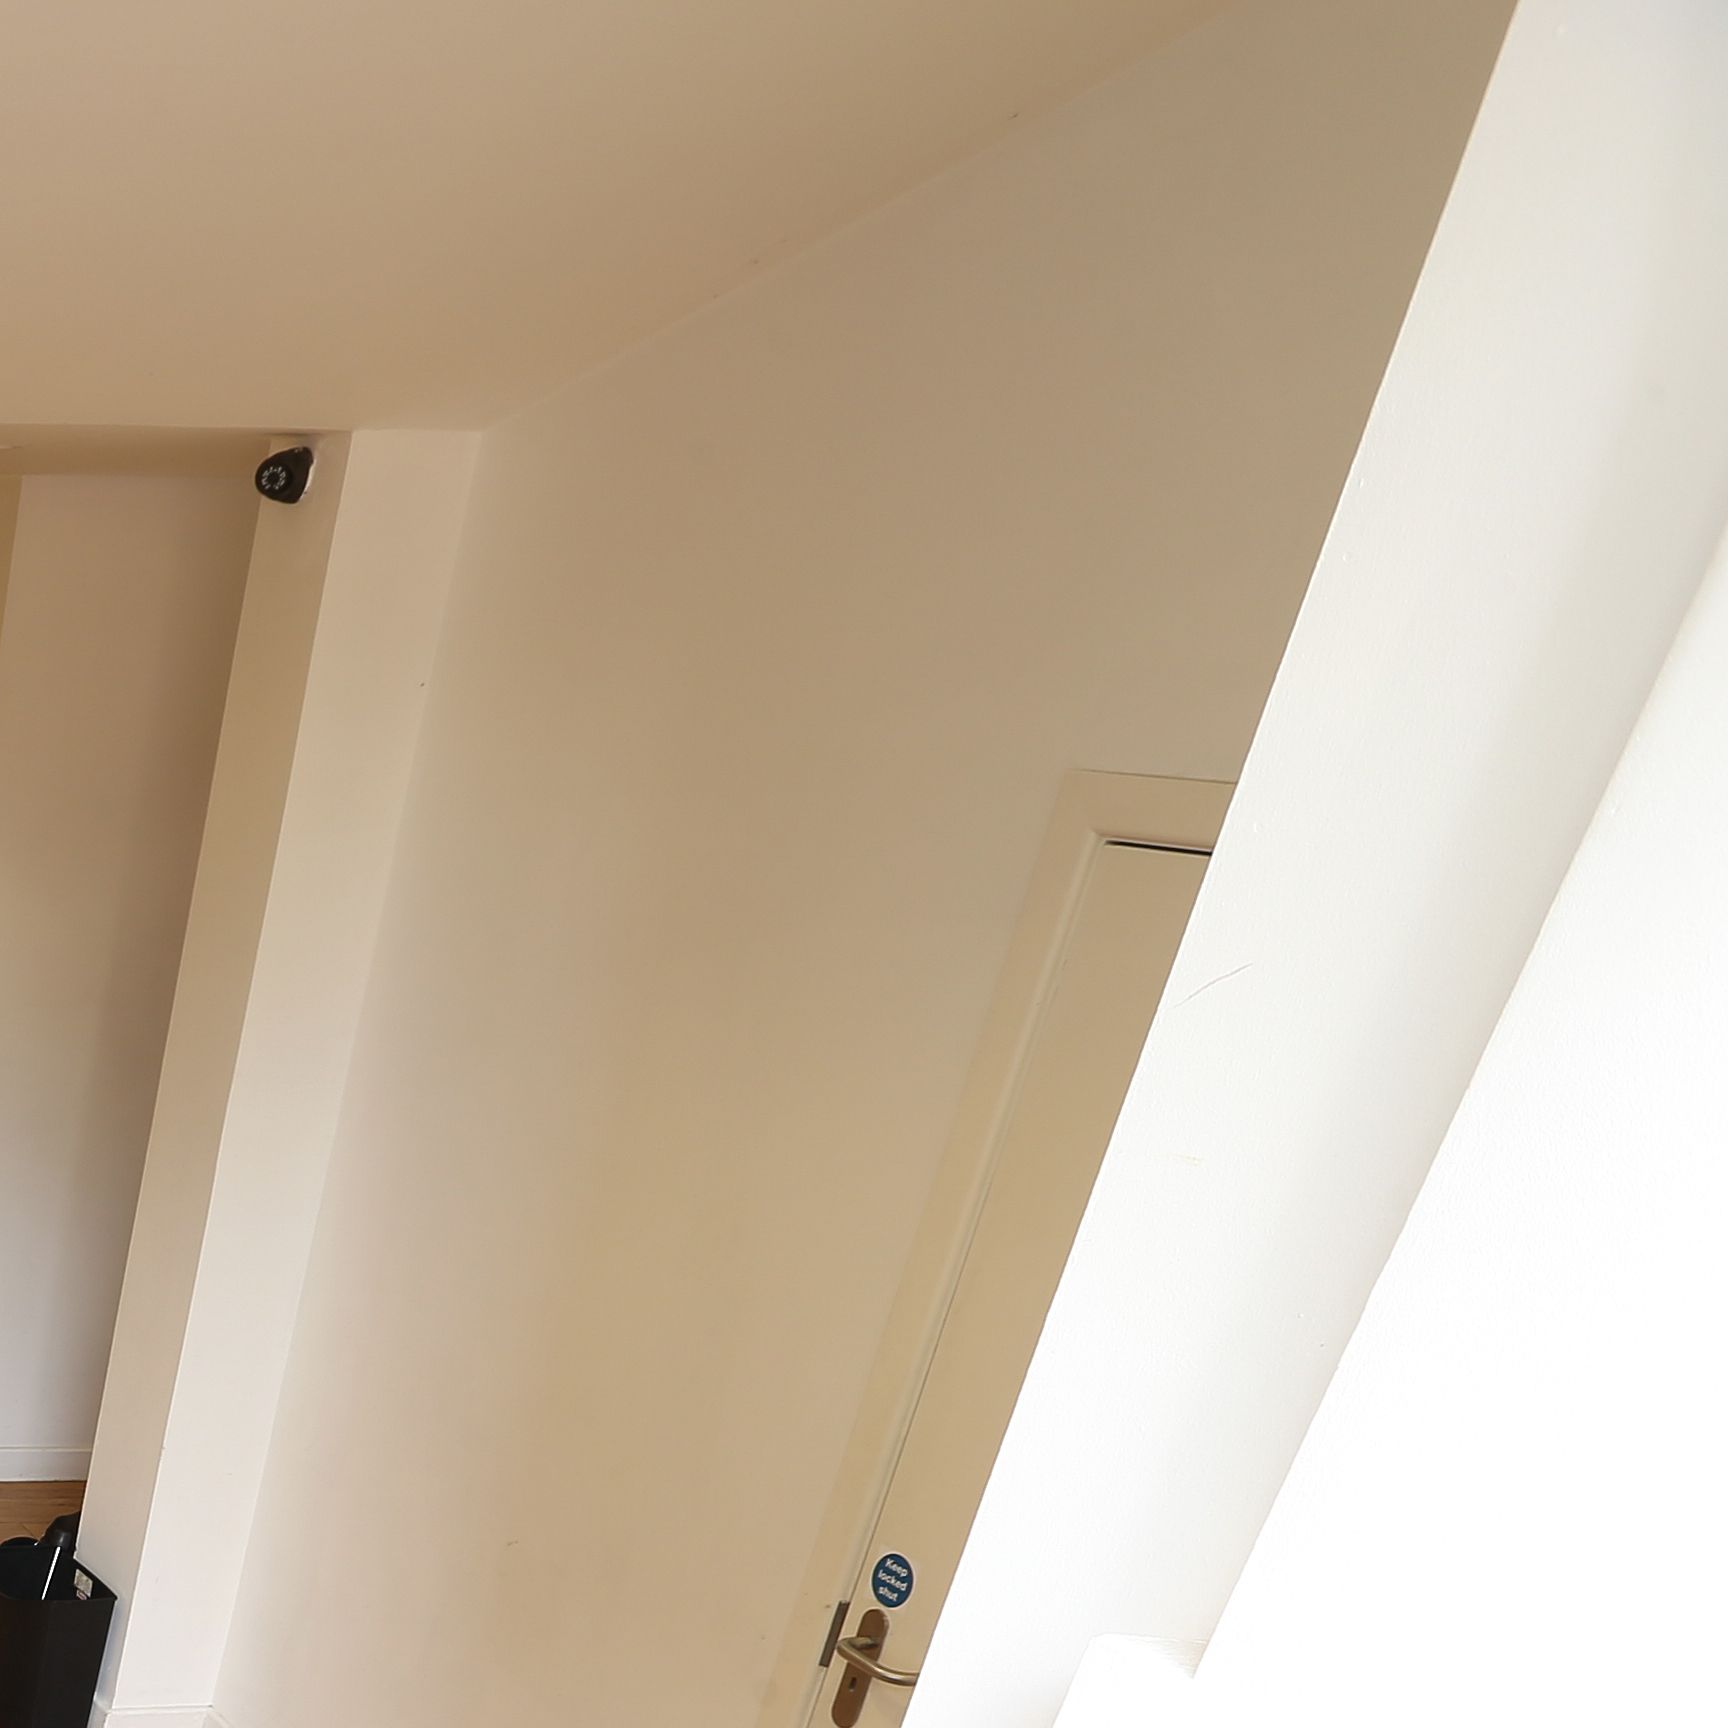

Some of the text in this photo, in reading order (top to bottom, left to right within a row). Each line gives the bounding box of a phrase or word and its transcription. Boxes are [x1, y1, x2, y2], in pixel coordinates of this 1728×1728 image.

[885, 1558, 908, 1577] Keep
[878, 1569, 908, 1591] locked
[879, 1586, 898, 1602] shut
